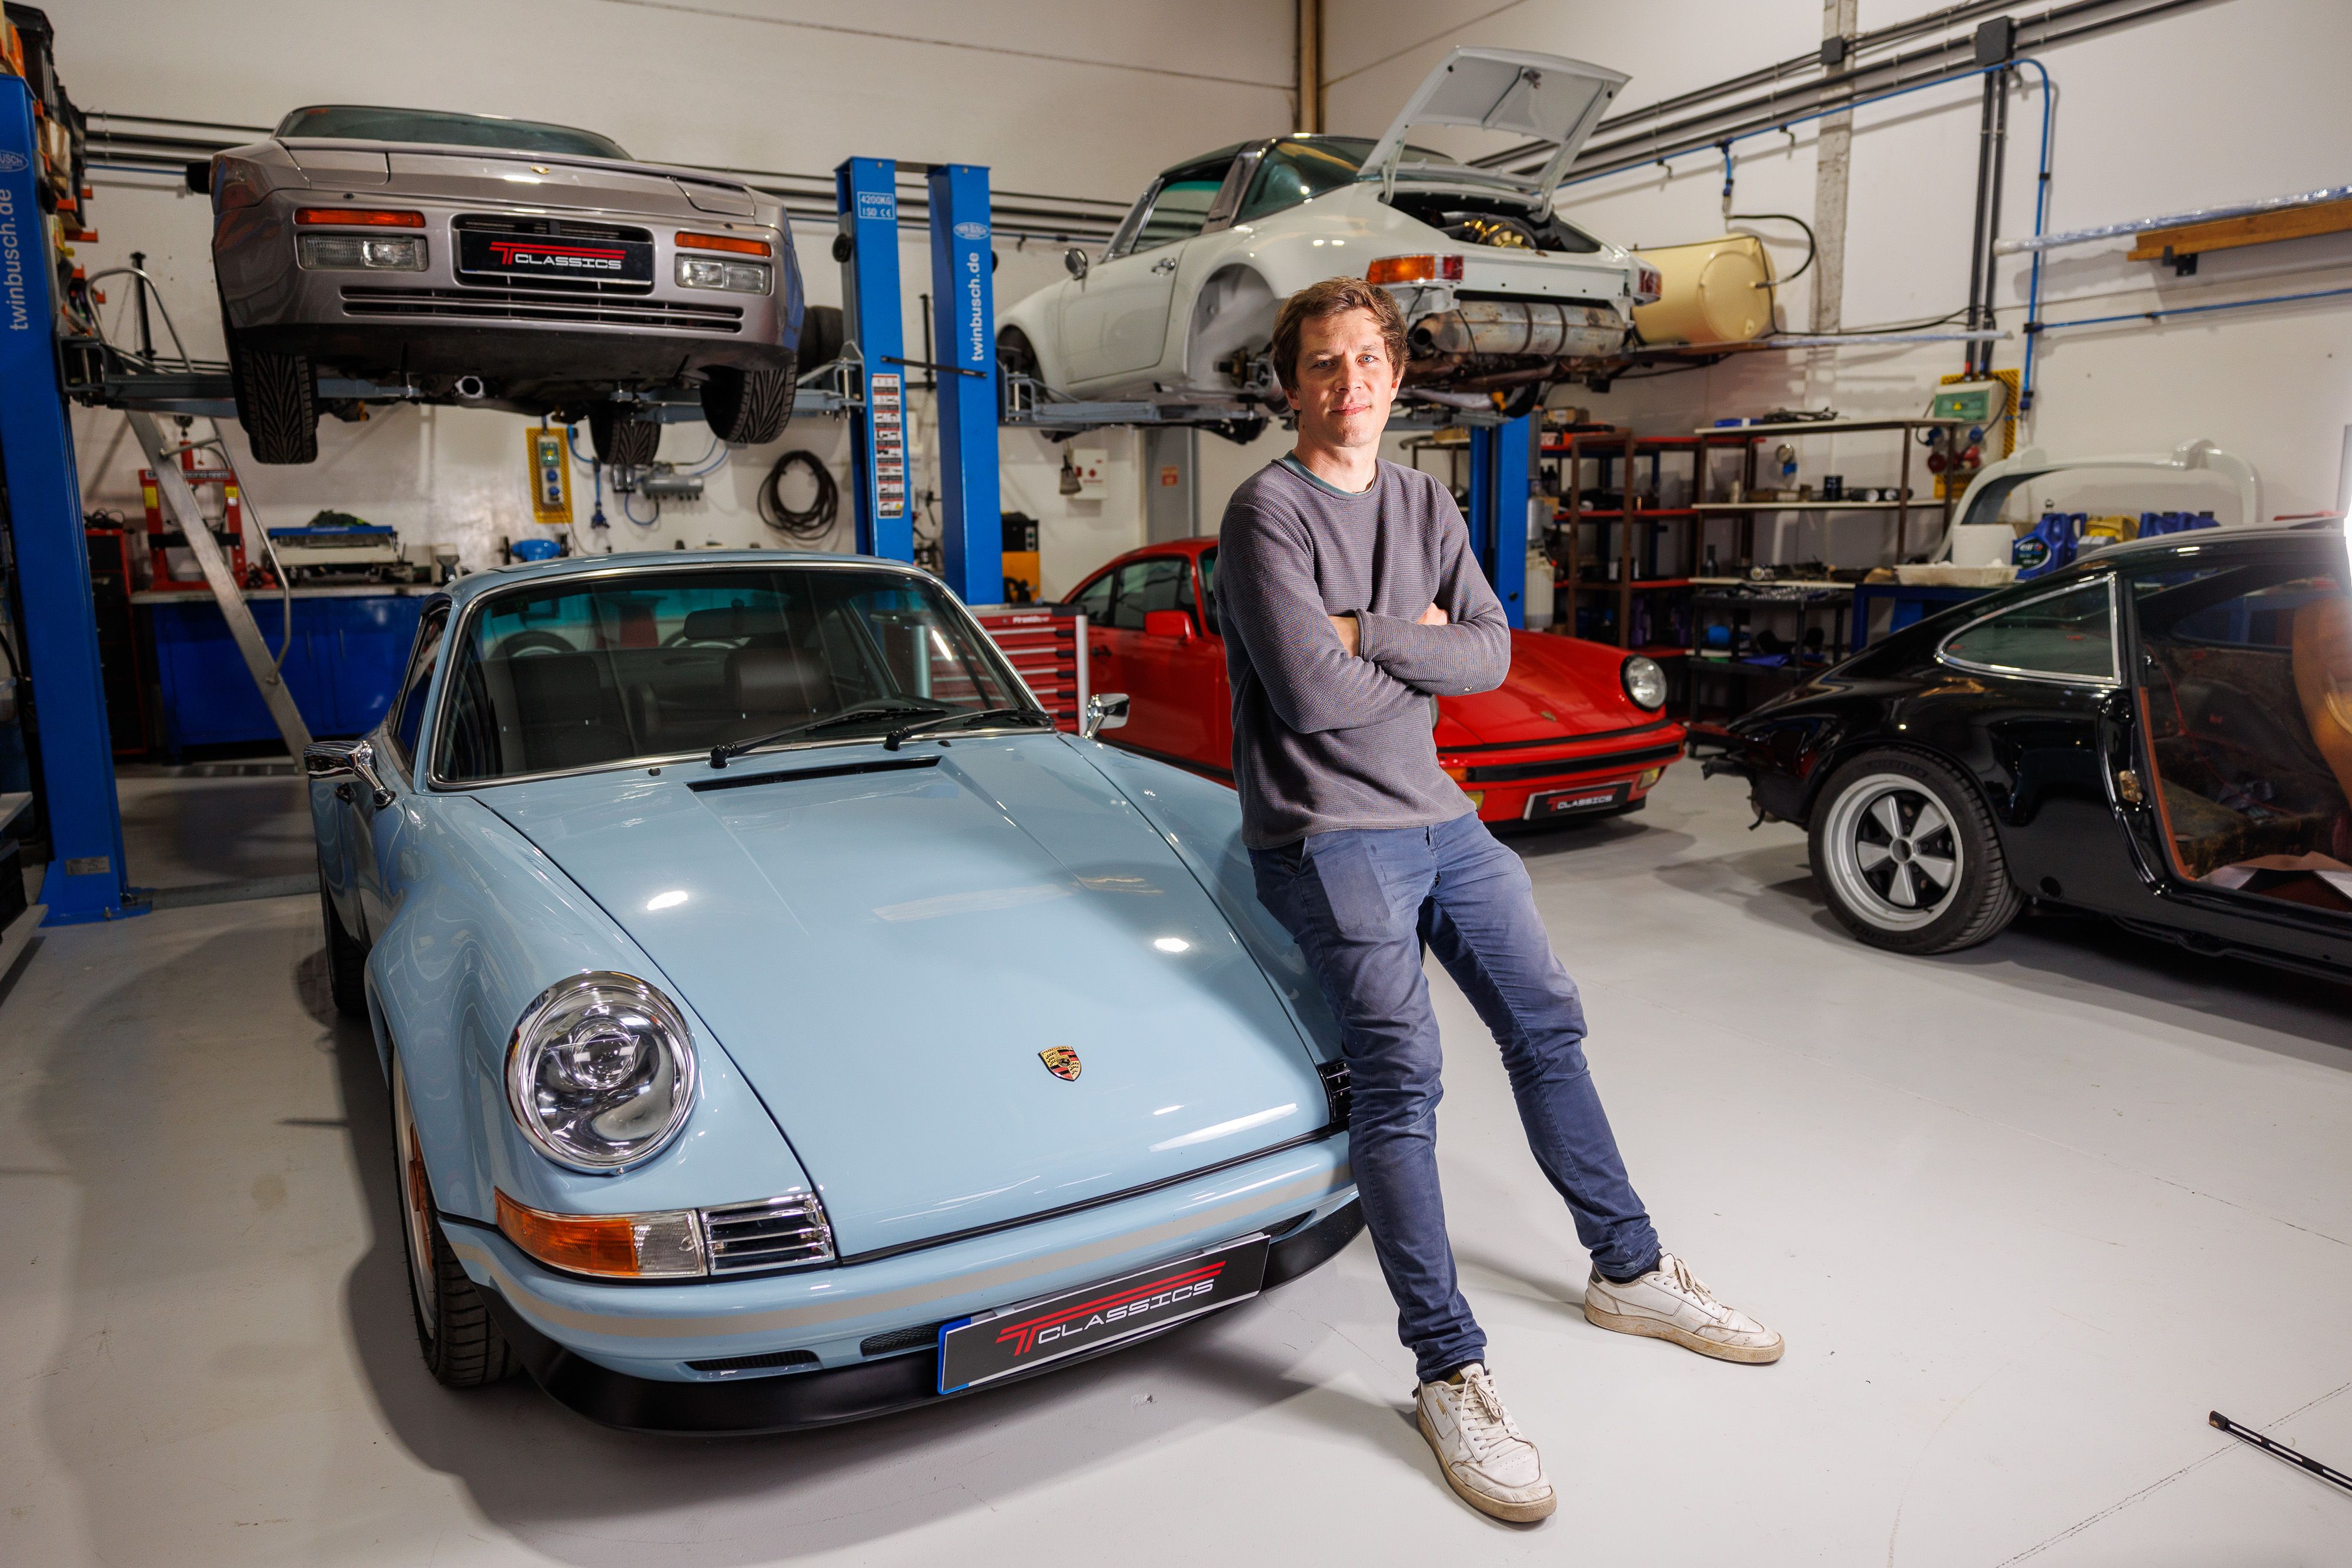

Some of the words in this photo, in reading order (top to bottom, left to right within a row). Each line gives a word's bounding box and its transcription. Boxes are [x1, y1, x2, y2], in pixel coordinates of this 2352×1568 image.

[0, 189, 29, 330] twinbusch.de
[515, 253, 622, 270] CLASSICS
[967, 252, 984, 361] twinbusch.de
[2019, 543, 2034, 551] elf
[1557, 795, 1613, 810] CLASSICS
[1038, 1279, 1215, 1345] CLASSICS
[1436, 1398, 1446, 1415] PUMA
